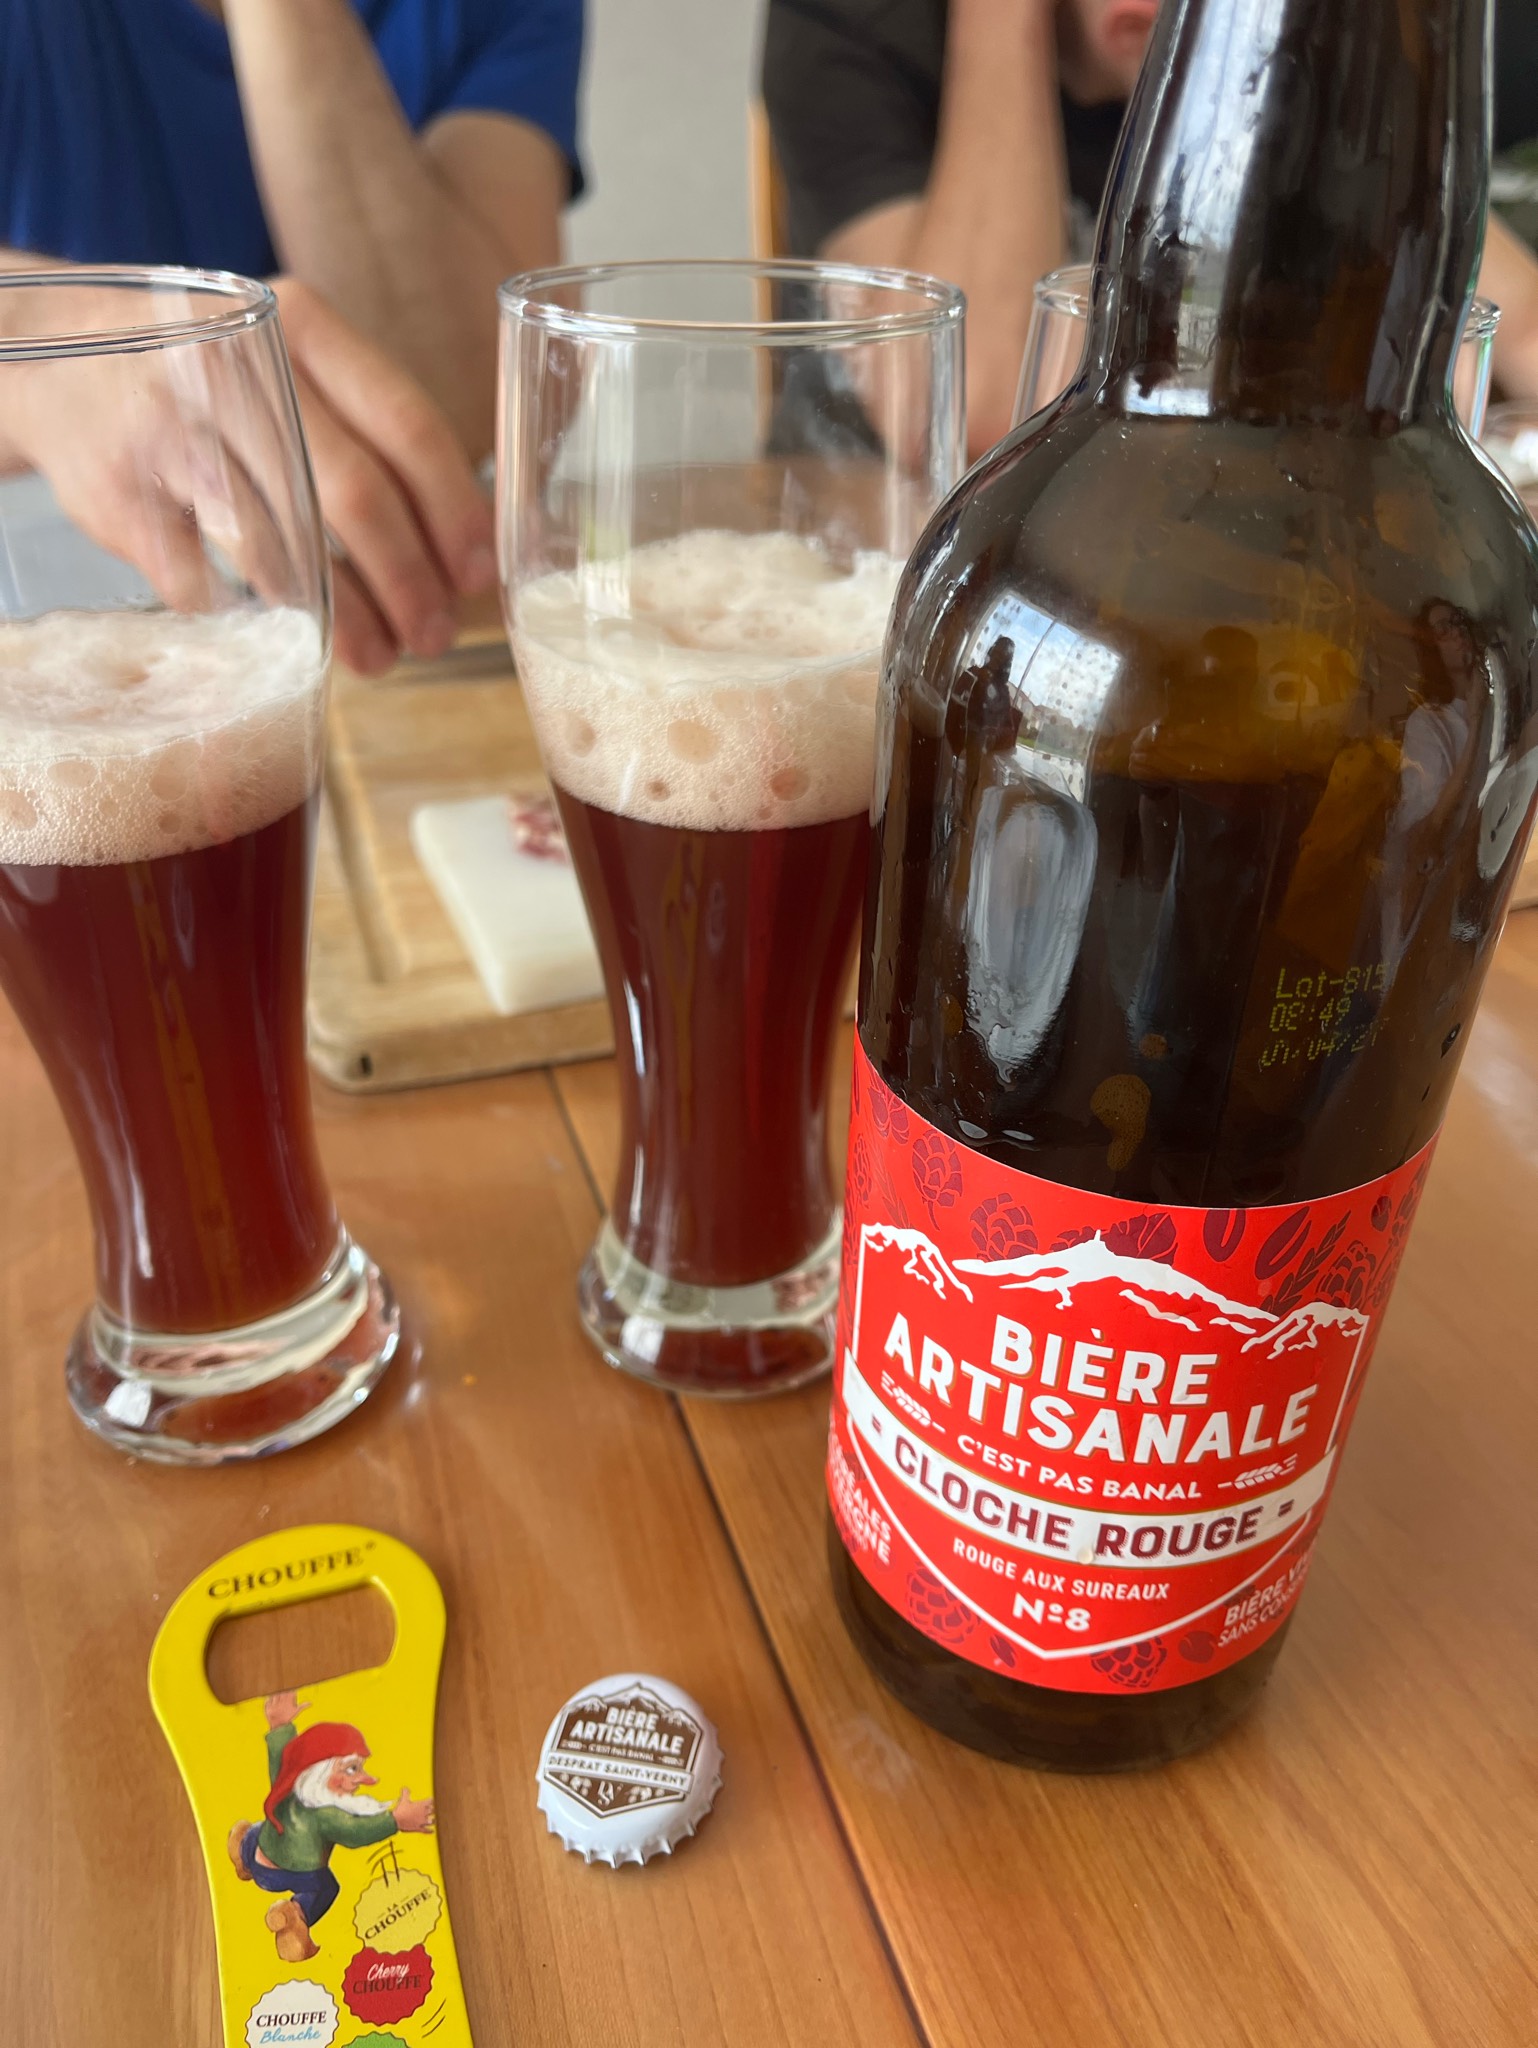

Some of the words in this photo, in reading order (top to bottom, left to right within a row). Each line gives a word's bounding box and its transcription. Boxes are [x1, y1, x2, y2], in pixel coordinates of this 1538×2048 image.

[990, 1313, 1218, 1406] BIÈRE
[883, 1312, 1319, 1465] ARTISANALE
[957, 1435, 1032, 1478] C'EST
[1038, 1466, 1093, 1494] PAS
[1102, 1479, 1201, 1500] BANAL
[895, 1434, 1074, 1550] CLOCHE
[1095, 1505, 1264, 1560] ROUGE
[208, 1548, 363, 1599] CHOUFFE
[953, 1537, 1018, 1579] ROUGE
[1022, 1568, 1065, 1593] AUX
[1071, 1579, 1170, 1601] SUREAUX
[1224, 1574, 1287, 1627] BIÈRE
[1217, 1613, 1259, 1648] SANS
[605, 1705, 659, 1731] BIÈRE
[569, 1720, 684, 1755] ARTISANALE
[549, 1755, 602, 1772] DESPRAT
[604, 1761, 688, 1787] SAINT-VERNY
[364, 1889, 432, 1940] CHOUFFE
[387, 1902, 399, 1913] LA
[352, 1975, 423, 1995] CHOUFFE
[367, 1962, 410, 1984] Cherry
[256, 2010, 327, 2028] CHOUFFE
[259, 2025, 321, 2044] Blanche
